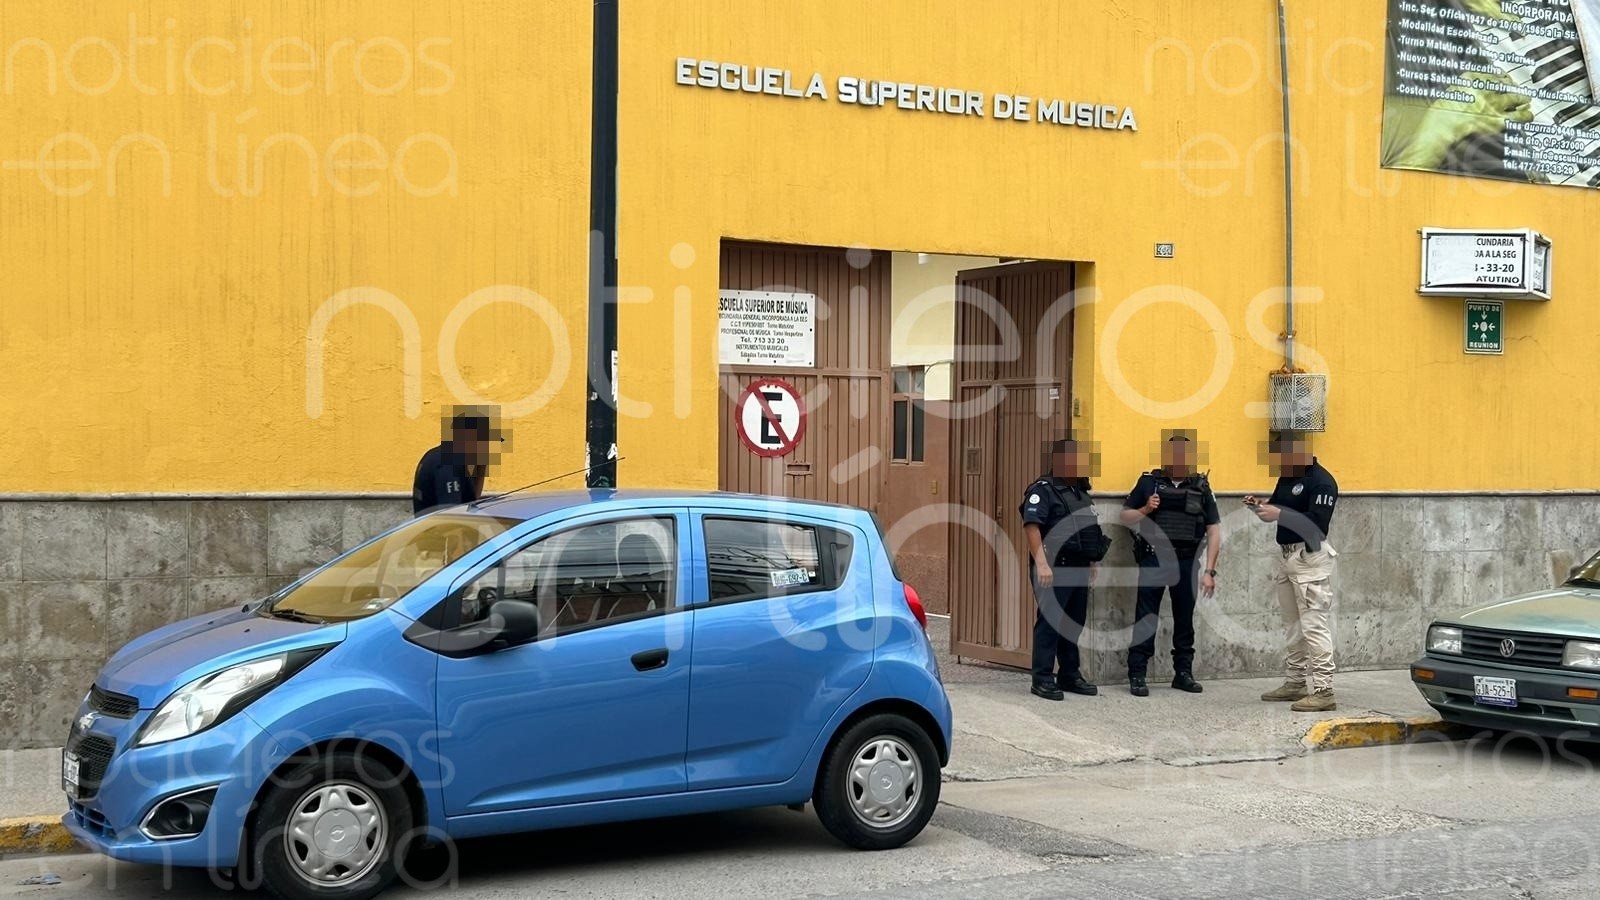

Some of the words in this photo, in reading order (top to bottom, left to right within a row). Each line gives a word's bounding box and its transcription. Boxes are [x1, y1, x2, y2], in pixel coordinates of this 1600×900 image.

[1501, 2, 1573, 23] INCORPORADA
[1486, 19, 1497, 27] de
[1545, 28, 1552, 37] a
[1553, 28, 1562, 38] la
[1465, 45, 1477, 55] de
[1499, 53, 1505, 61] a
[1429, 56, 1458, 69] Modelo
[1460, 61, 1502, 74] Educativo
[1430, 73, 1470, 87] Sabatinos
[1472, 79, 1484, 88] de
[676, 57, 828, 100] ESCUELA
[837, 76, 985, 116] SUPERIOR
[993, 94, 1031, 121] DE
[1037, 98, 1138, 131] MUSICA
[1430, 89, 1474, 102] Accesibles
[1505, 119, 1522, 130] Tres
[1524, 122, 1555, 135] Guerras
[1504, 133, 1524, 144] León
[1503, 146, 1531, 158] E-mail:
[1503, 160, 1518, 169] Tel:
[1476, 238, 1514, 246] CUNDARIA
[1485, 250, 1491, 258] A
[1492, 250, 1501, 258] LA
[1503, 250, 1517, 259] SEG
[1476, 275, 1519, 284] ATUTINO
[718, 297, 744, 311] SCUELA
[745, 298, 775, 313] SUPERIOR
[776, 300, 784, 313] DE
[760, 392, 783, 444] E
